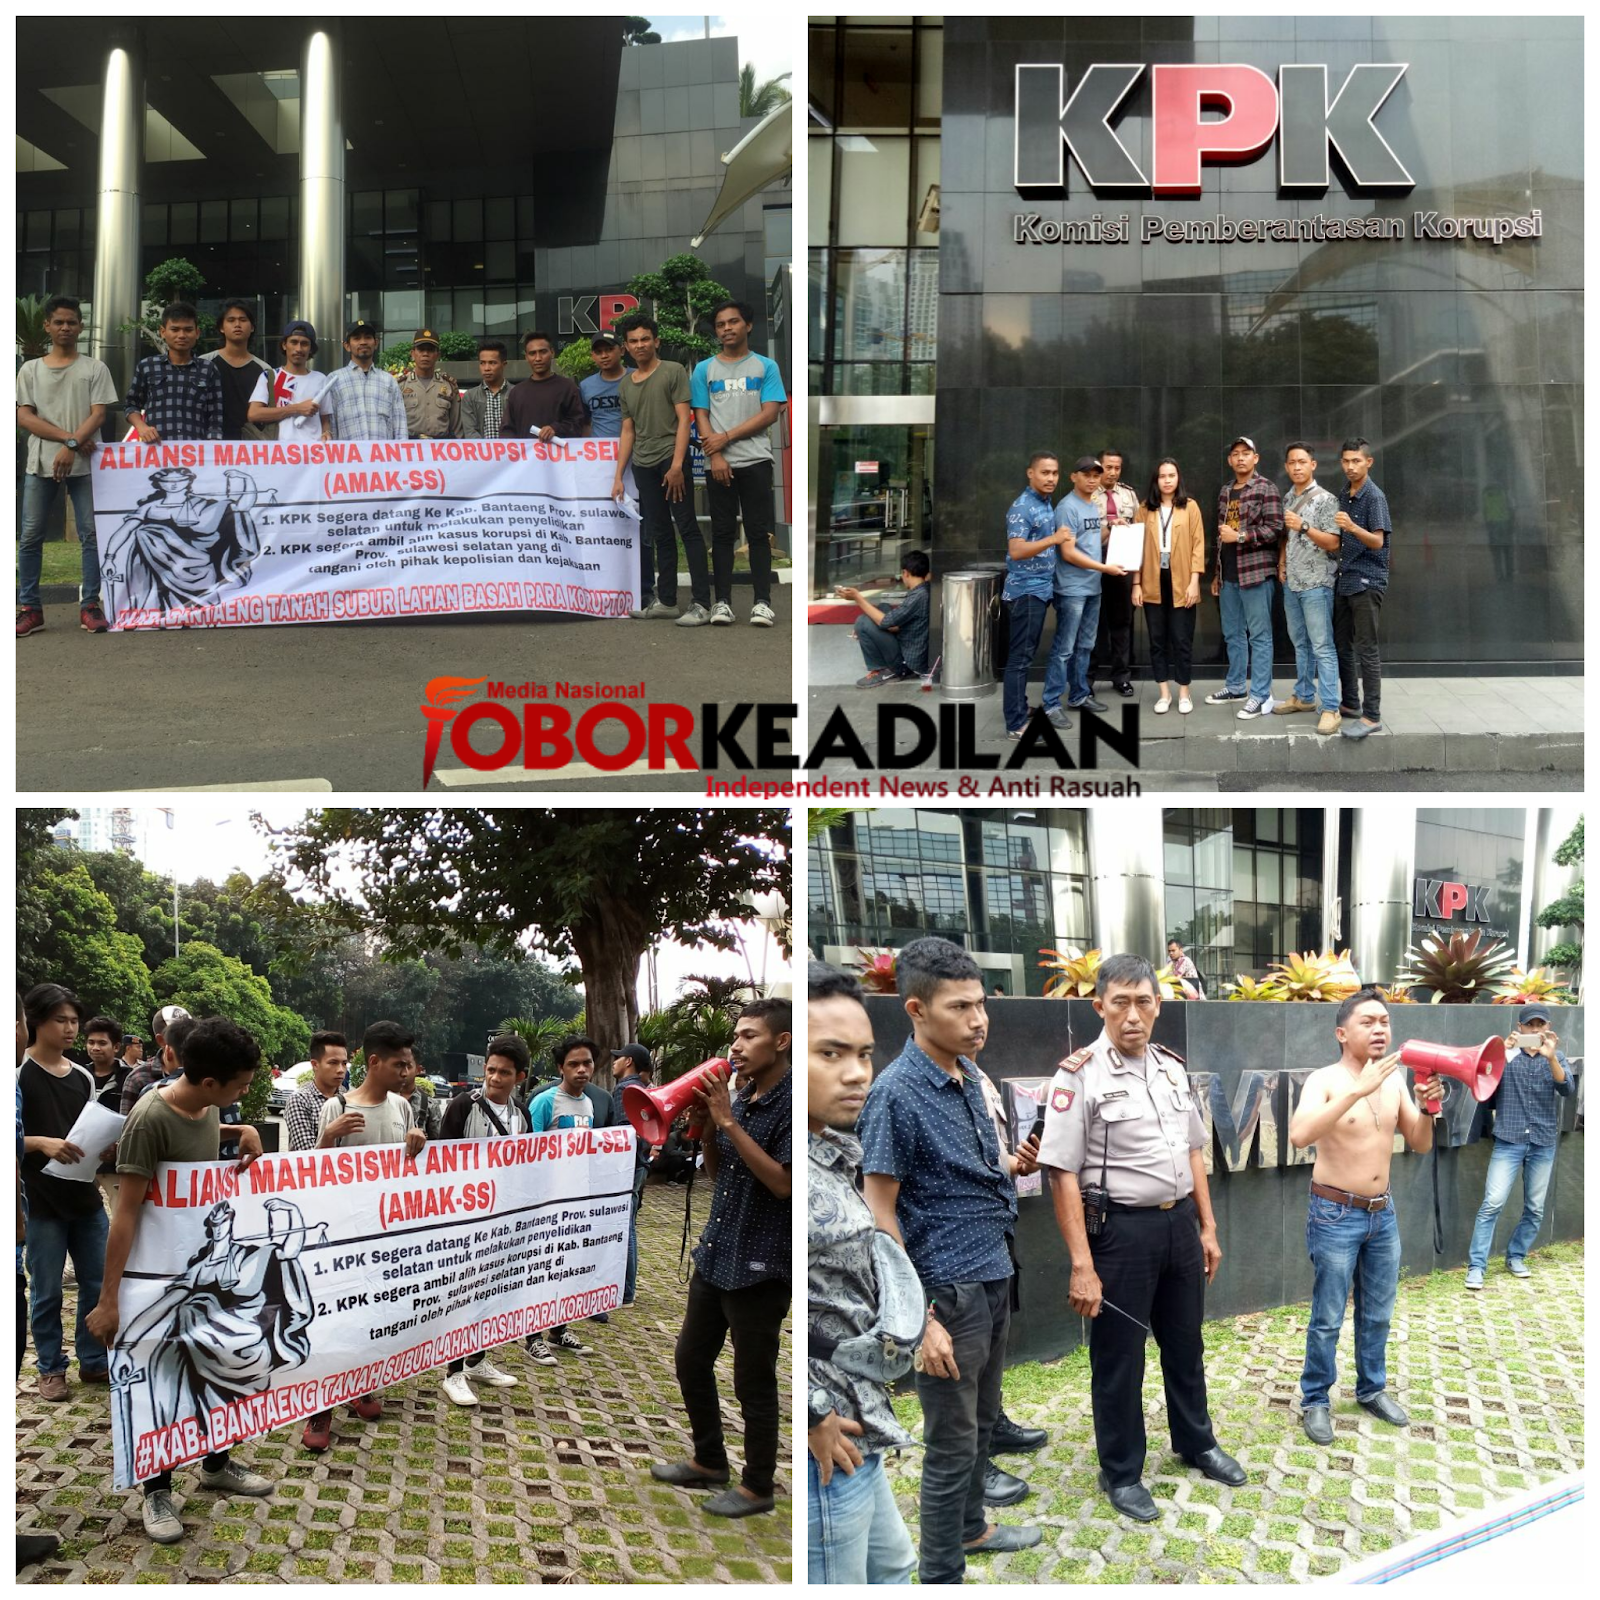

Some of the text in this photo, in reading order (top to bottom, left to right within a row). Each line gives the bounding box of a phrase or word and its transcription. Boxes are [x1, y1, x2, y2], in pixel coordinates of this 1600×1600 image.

[1014, 63, 1416, 196] KPK
[1013, 209, 1543, 245] Komisi Pemberantasan Korupsi
[558, 294, 640, 335] KP
[100, 444, 204, 470] ALIANSI
[214, 443, 363, 466] MAHASISWA
[370, 442, 424, 463] ANTI
[432, 442, 527, 463] KORUPSI
[324, 469, 445, 499] (AMAK-SS)
[262, 503, 631, 526] 1. KPK Segera datang Ke Kab. Bantaeng Prov. sulawe
[327, 524, 380, 537] selatan
[385, 521, 423, 532] untuk
[508, 514, 585, 531] penyelidikan
[263, 545, 276, 556] 2.
[281, 543, 312, 555] KPK
[316, 540, 364, 554] segera
[368, 536, 404, 547] ambil
[438, 530, 478, 540] kasus
[482, 529, 532, 541] korupsi
[535, 529, 547, 539] di
[550, 530, 572, 544] Kab.
[575, 535, 632, 549] Bantaeng
[355, 541, 562, 560] Prov. sulawesi selatan yang di
[400, 555, 439, 569] pihak
[443, 553, 514, 566] kepolisian
[518, 553, 542, 564] dan
[546, 555, 601, 571] kejaksaan
[265, 591, 332, 622] TANAH
[334, 588, 396, 618] SUBUR
[397, 584, 461, 614] LAHAN
[461, 581, 521, 611] BASAH
[523, 581, 565, 611] PARA
[566, 585, 634, 617] KORUPTOR
[1415, 878, 1492, 923] KPK
[143, 1129, 632, 1209] ALIANSI MAHASISWA ANTI KORUPSI SUL-SEL
[379, 1180, 496, 1230] (AMAK-SS)
[314, 1201, 629, 1276] 1. KPK Segera datang Ke Kab. Bantaeng Prov. sulawesi
[383, 1223, 592, 1281] selatan untuk melakukan penyelidikan
[317, 1230, 623, 1317] 2. KPK segera ambil alih kasus korupsi di Kab. Bantaeng
[413, 1255, 564, 1311] Prov. sulawesi selatan yang di
[370, 1264, 596, 1340] tangani oleh pihak kepolisian dan kejaksaan
[135, 1284, 619, 1479] #KAB. BANTAENG TANAH SUBUR LAHAN BASAH PARA KORUPTOR
